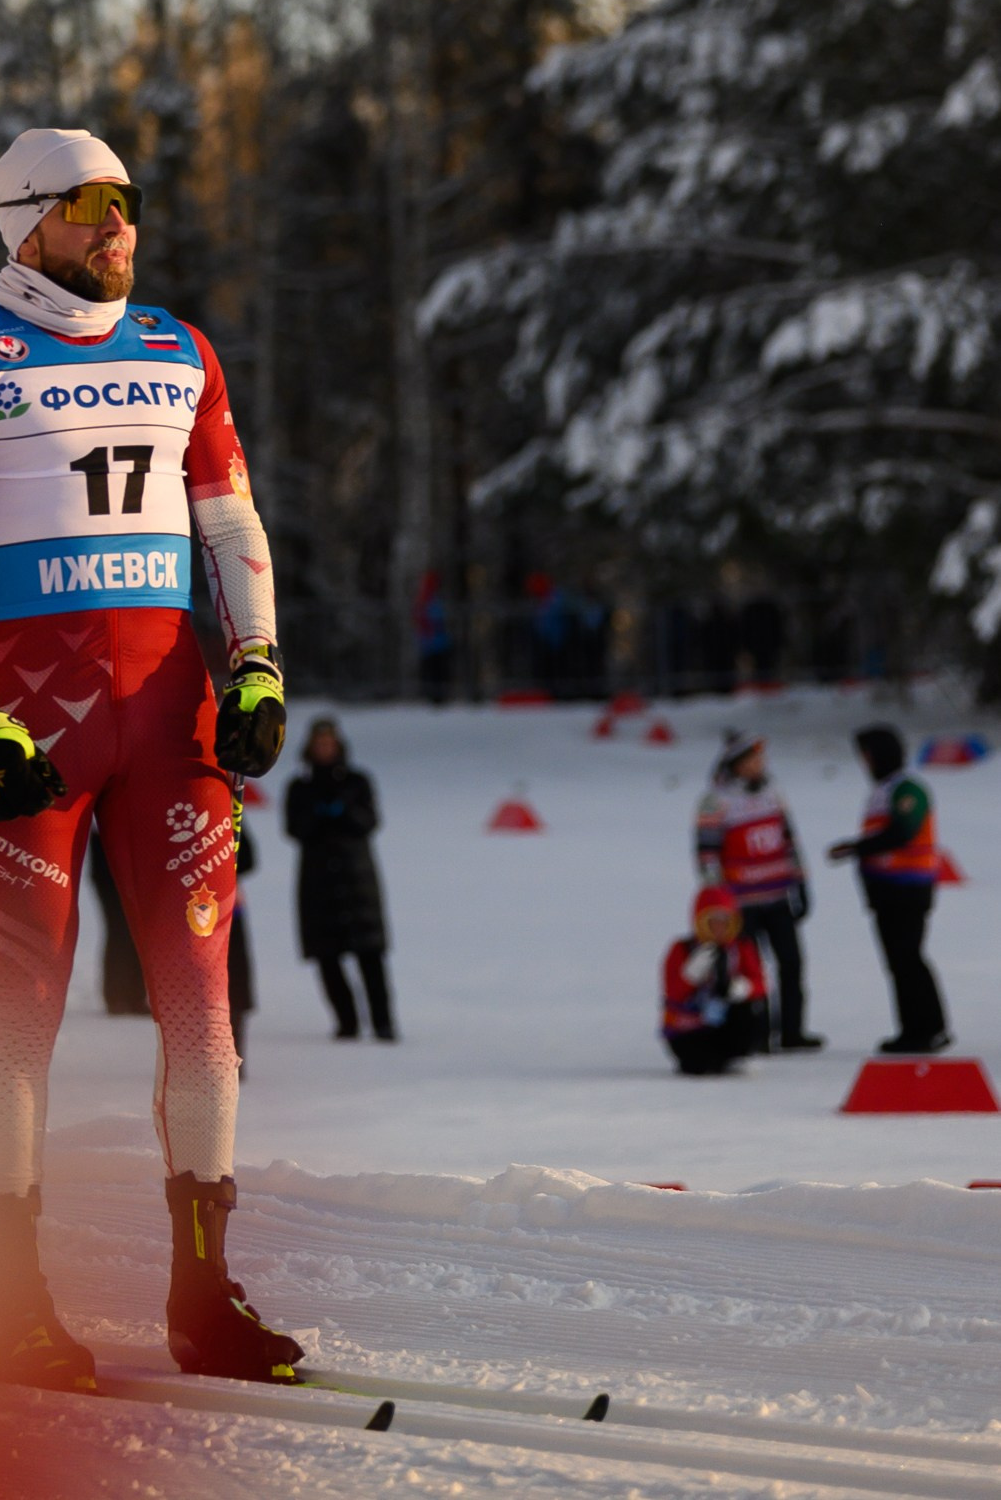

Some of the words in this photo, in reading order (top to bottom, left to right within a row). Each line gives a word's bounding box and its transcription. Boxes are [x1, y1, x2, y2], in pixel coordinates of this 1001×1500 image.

[40, 381, 197, 413] ФОСАГРО
[70, 444, 155, 516] 17
[38, 551, 178, 595] ИЖЕВСК
[166, 817, 232, 871] ФОСАГРО
